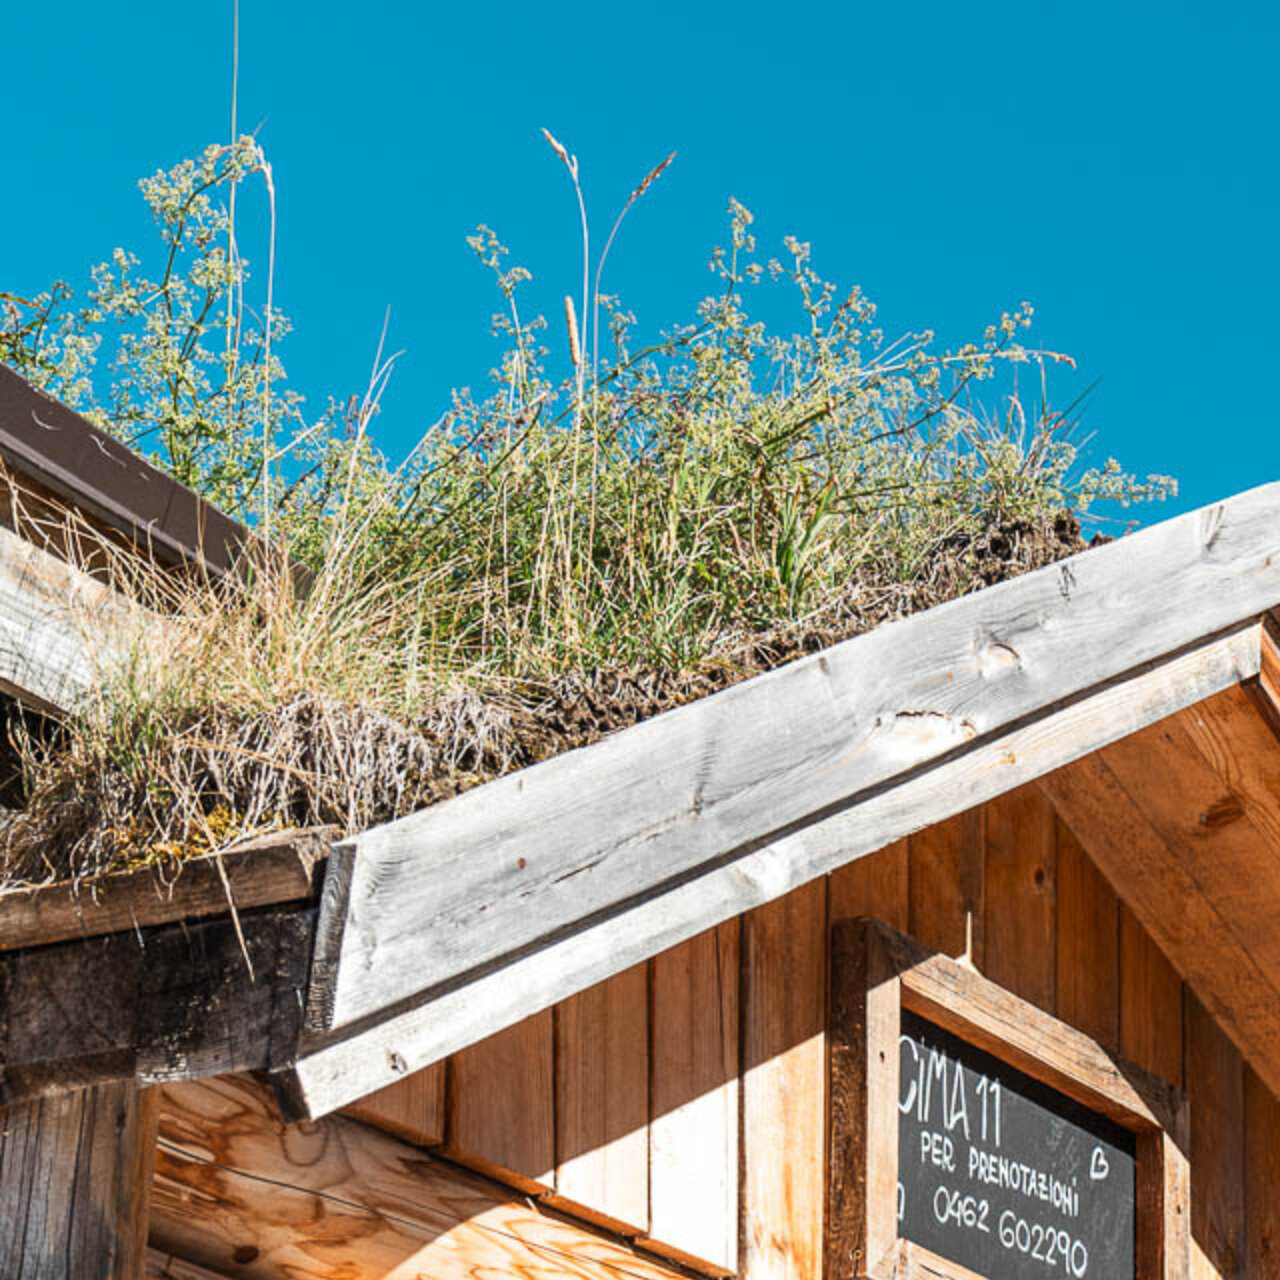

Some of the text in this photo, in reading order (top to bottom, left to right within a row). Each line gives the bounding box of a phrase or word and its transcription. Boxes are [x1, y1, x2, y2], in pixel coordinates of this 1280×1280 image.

[976, 1073, 1000, 1148] 11
[920, 1131, 957, 1173] PER
[933, 1186, 1088, 1279] 0462 602290
